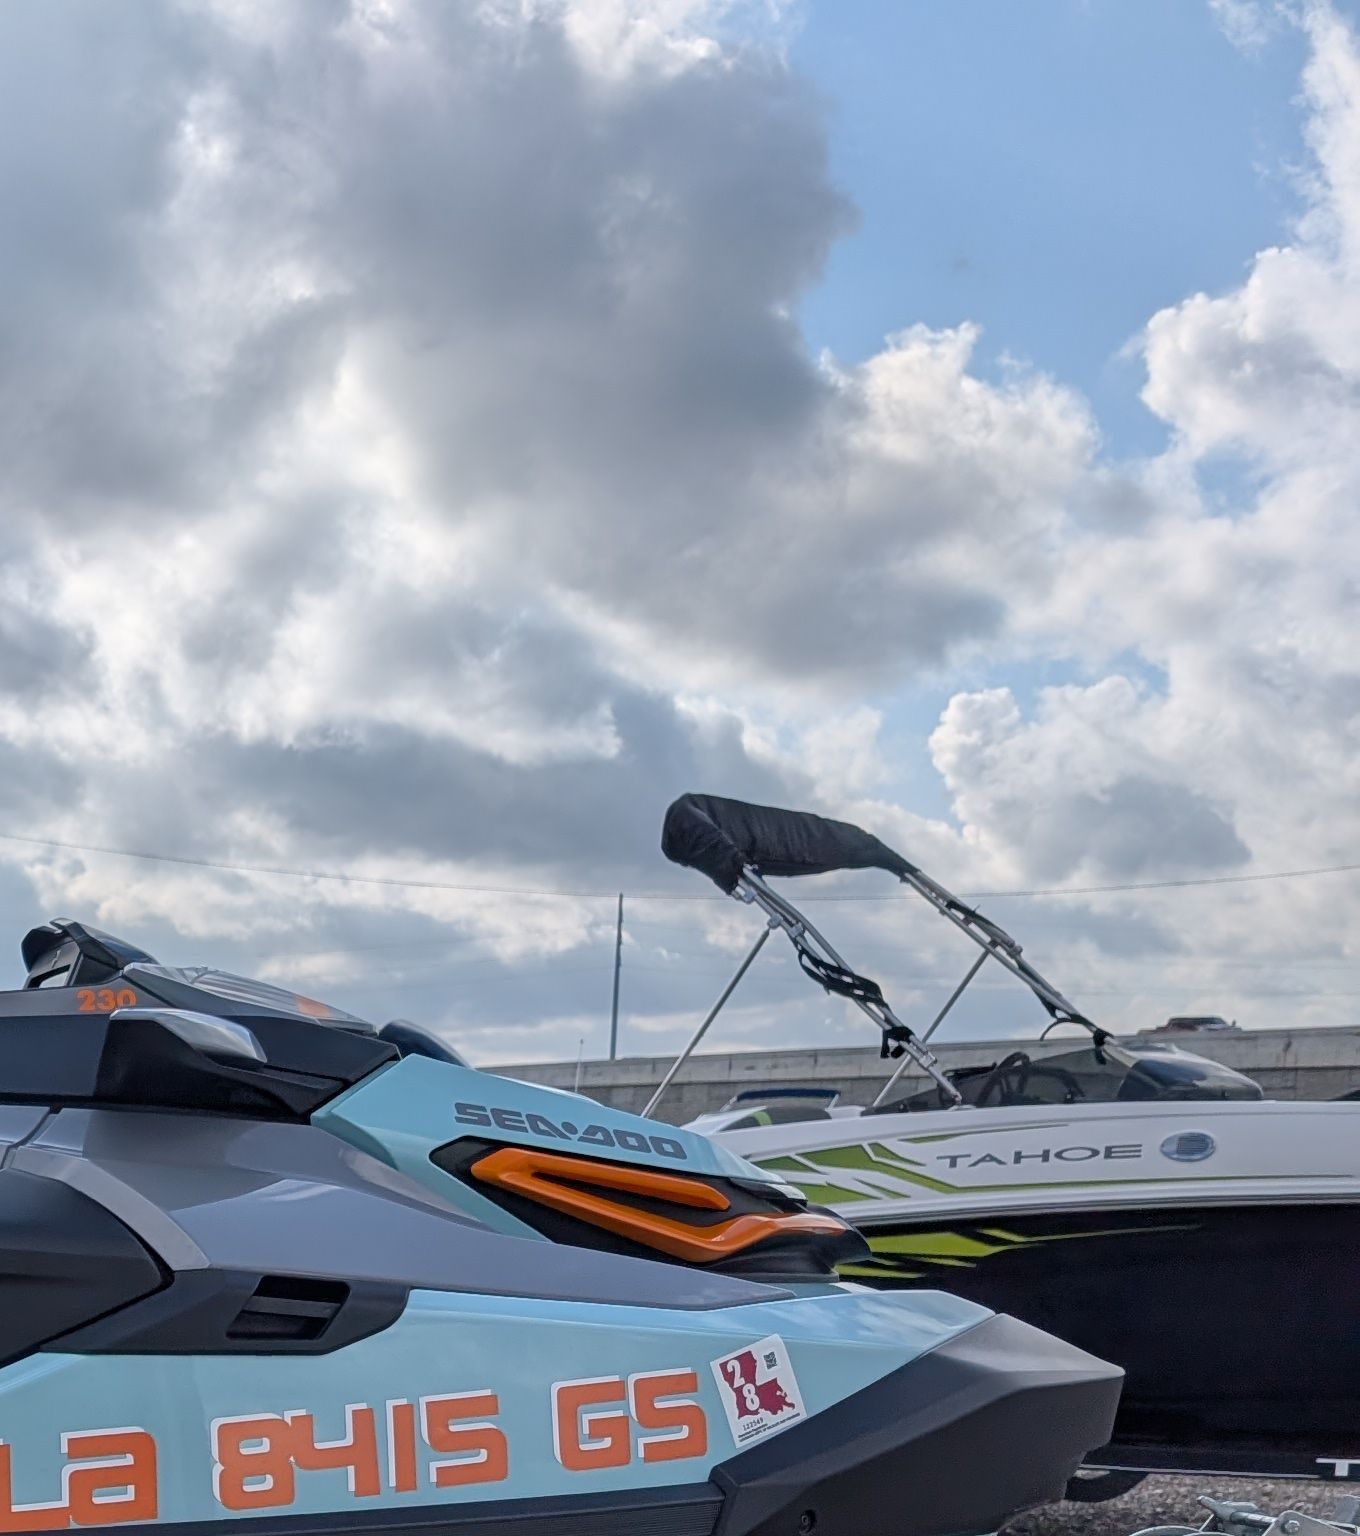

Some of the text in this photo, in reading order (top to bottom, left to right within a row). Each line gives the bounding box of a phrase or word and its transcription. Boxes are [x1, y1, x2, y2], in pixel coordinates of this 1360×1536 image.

[76, 988, 137, 1012] 230
[936, 1143, 1144, 1168] TAHOE
[211, 1388, 509, 1511] 8415
[552, 1367, 710, 1472] GS
